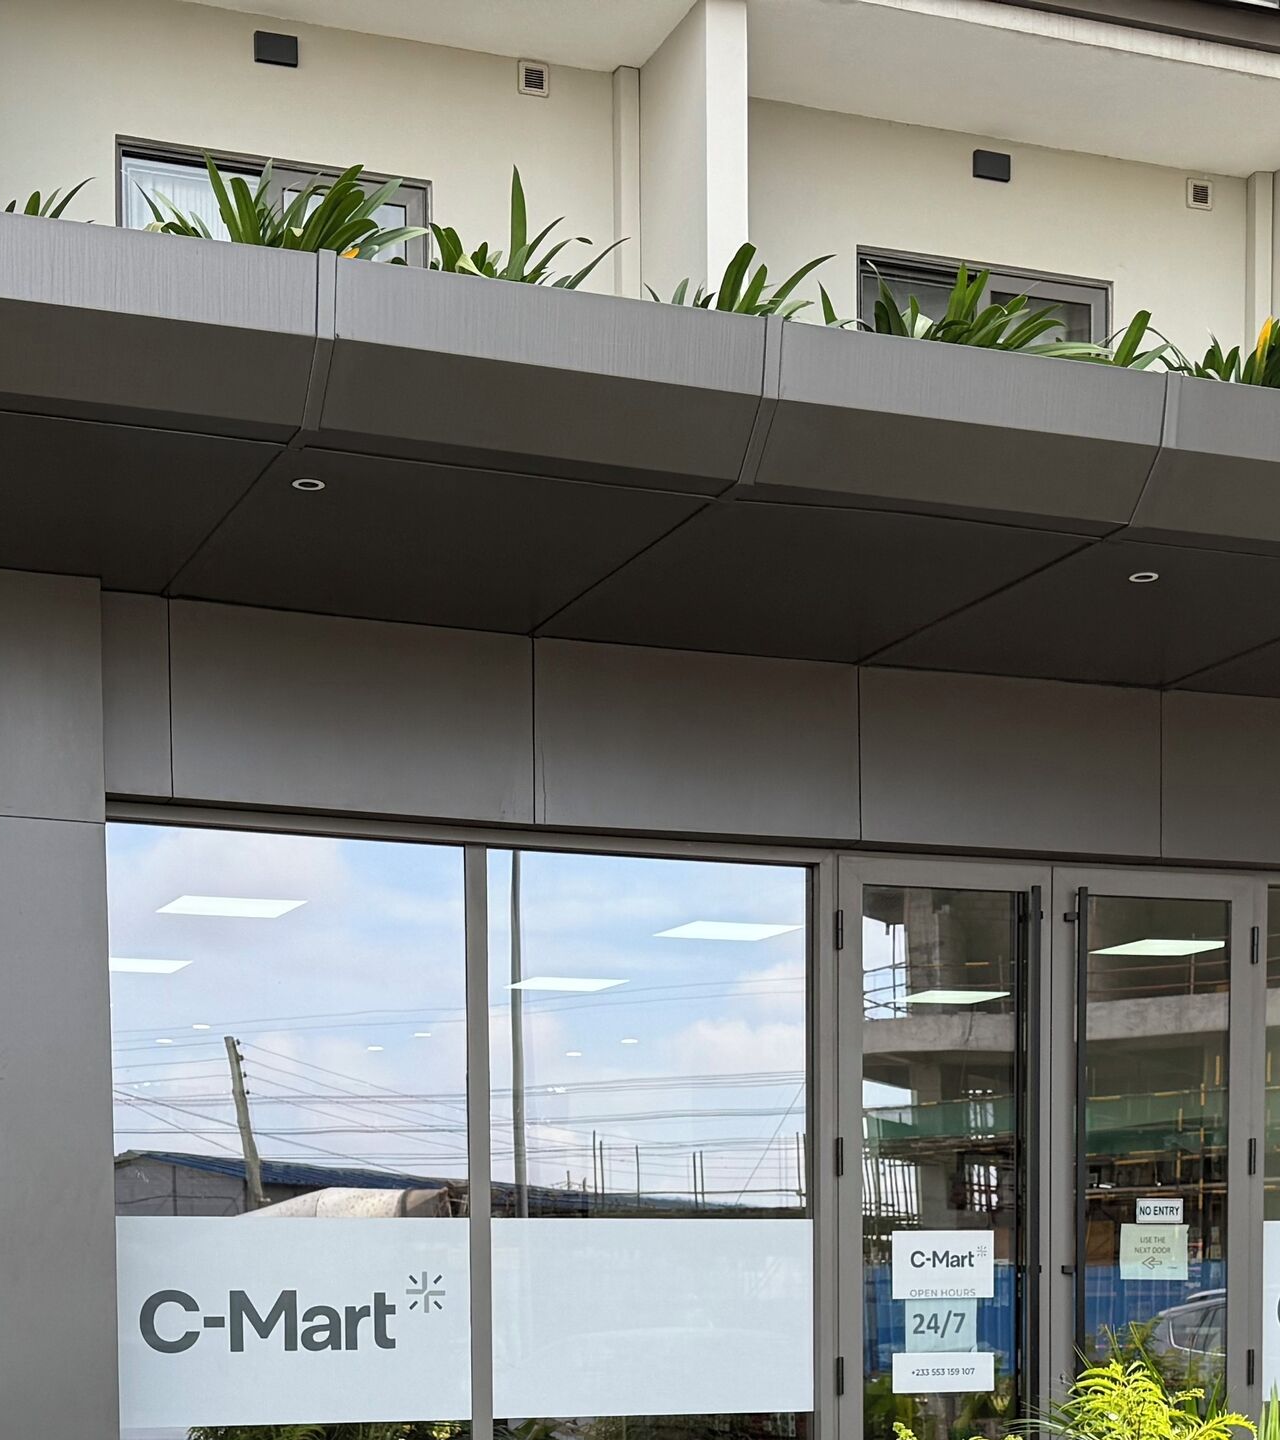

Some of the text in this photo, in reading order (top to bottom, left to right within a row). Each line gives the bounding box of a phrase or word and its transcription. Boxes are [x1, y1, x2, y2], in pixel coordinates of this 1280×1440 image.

[1139, 1206, 1180, 1216] NO ENTRY
[1140, 1236, 1166, 1244] USE THE
[910, 1250, 975, 1268] C-Mart
[909, 1288, 976, 1298] OPEN HOURS
[138, 1288, 397, 1355] C-Mart
[912, 1310, 966, 1339] 24/7
[911, 1367, 975, 1377] +233 553 159 107
